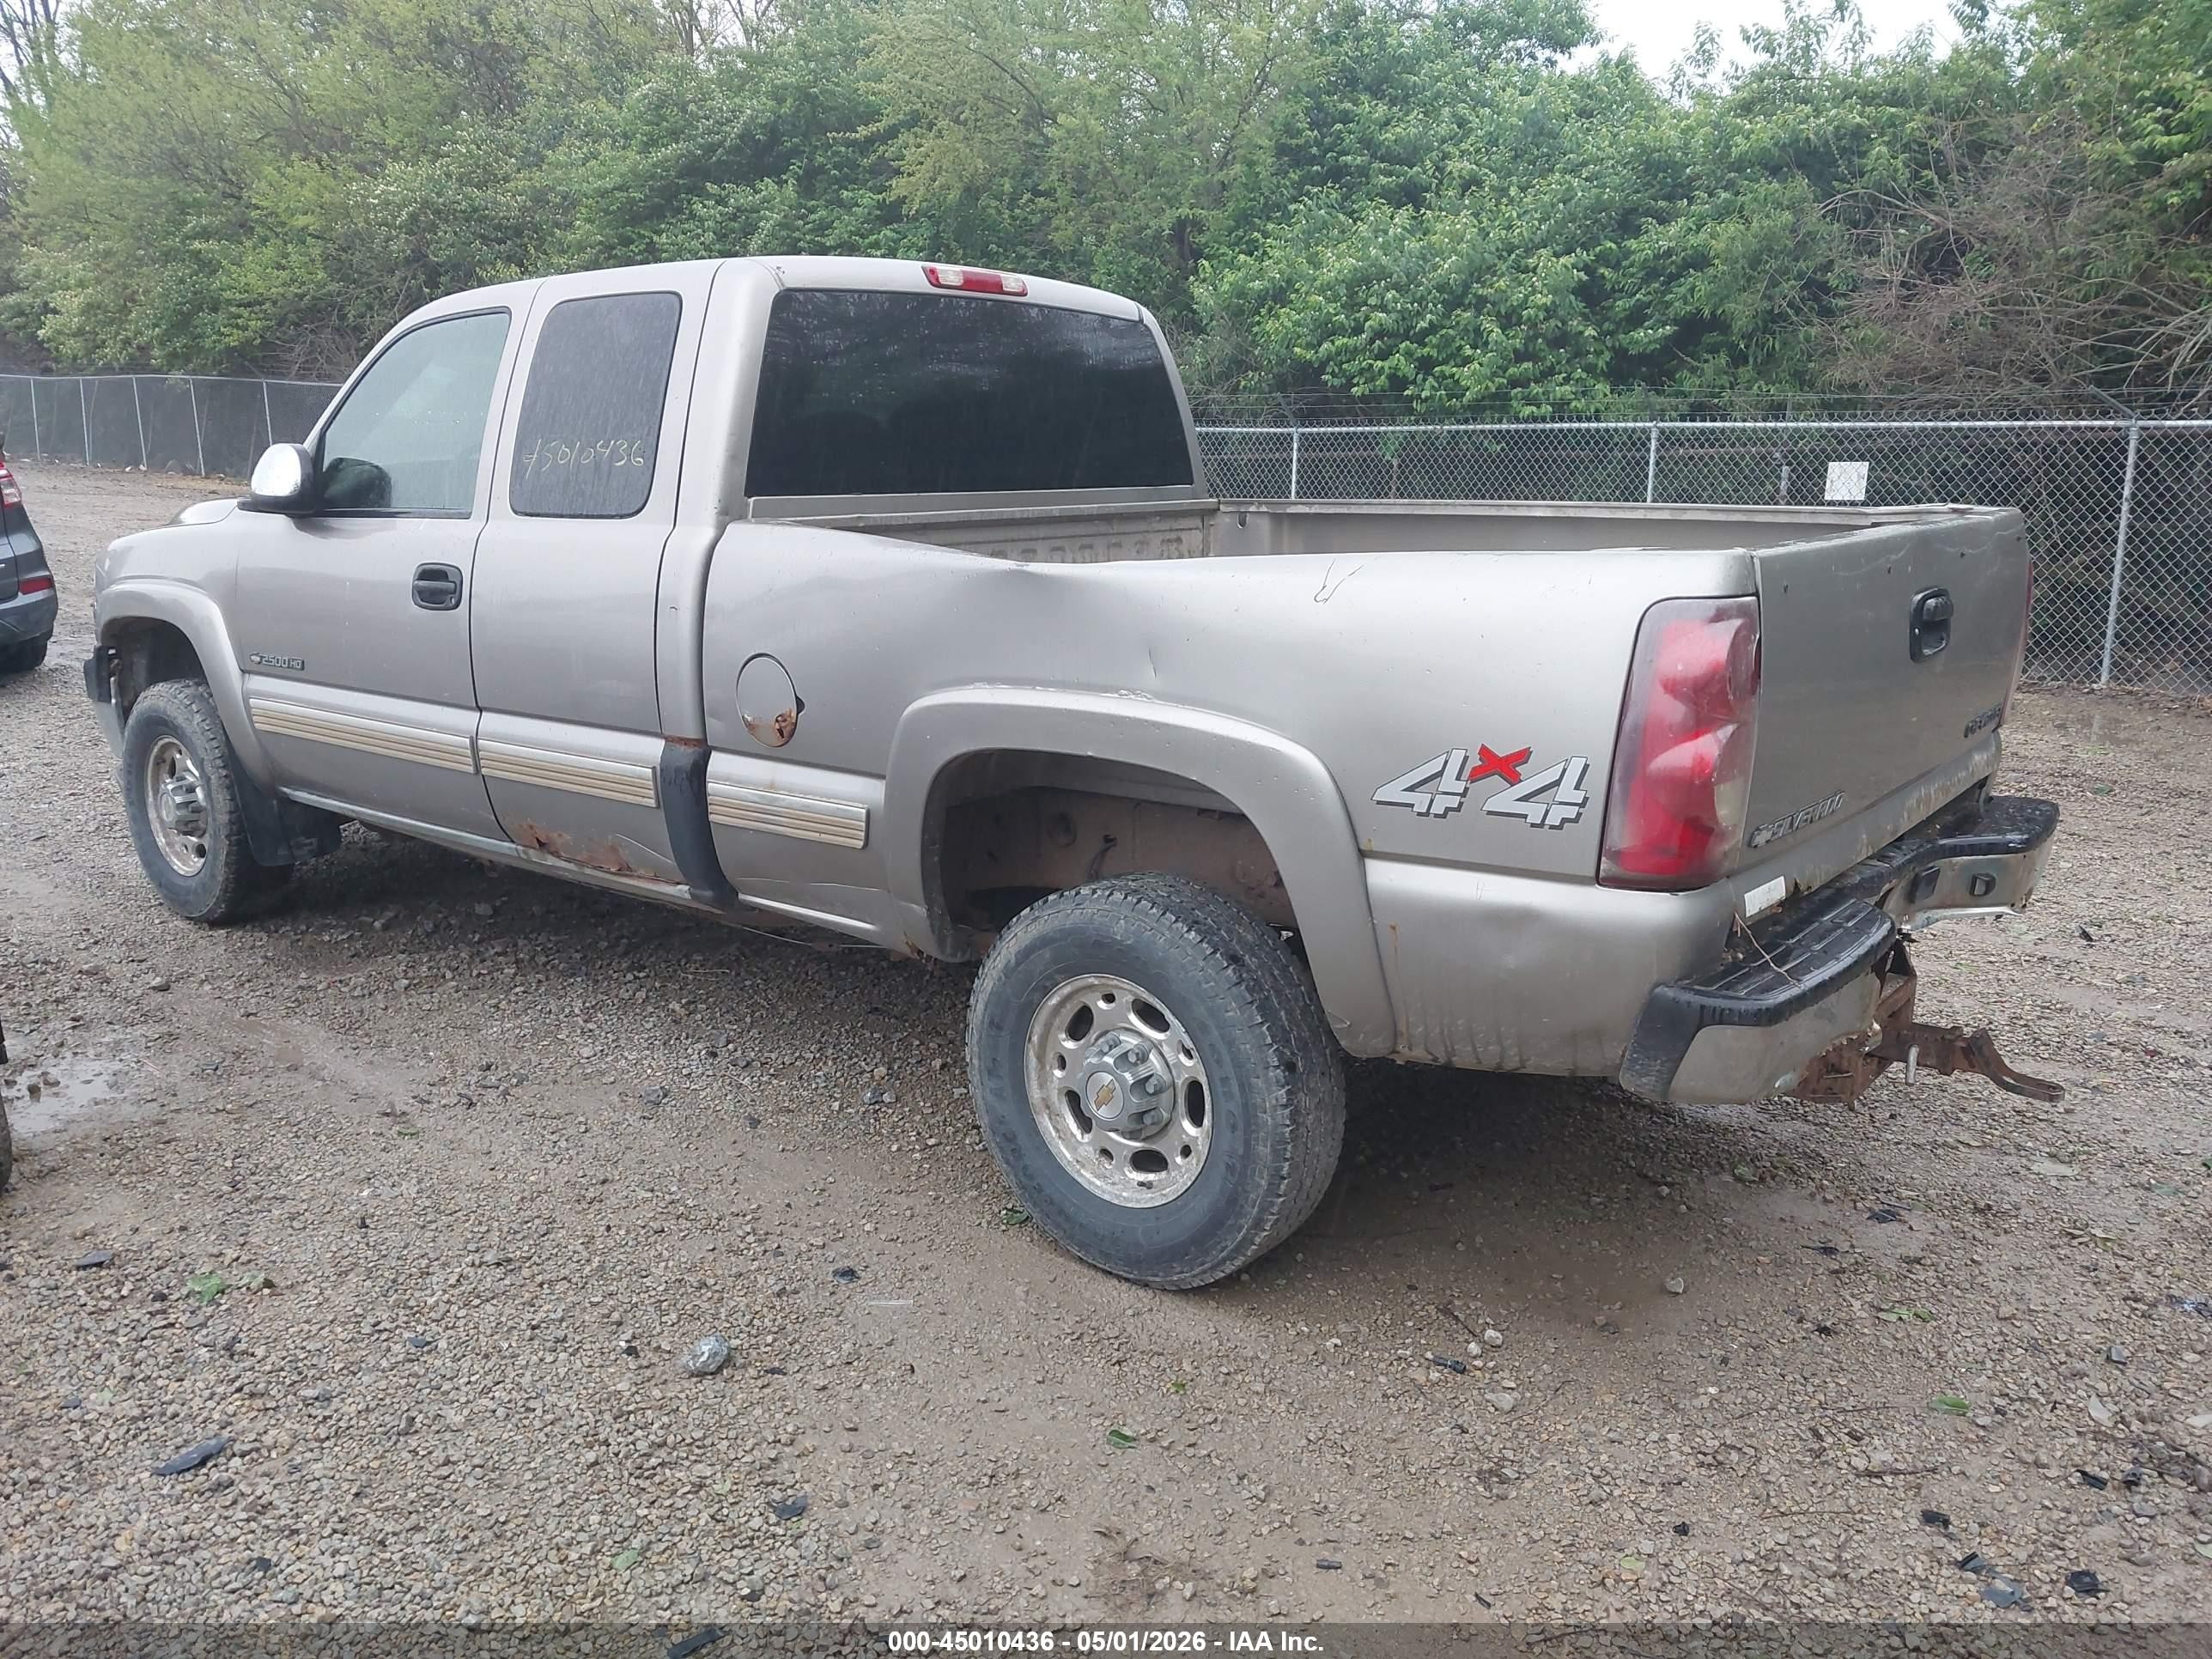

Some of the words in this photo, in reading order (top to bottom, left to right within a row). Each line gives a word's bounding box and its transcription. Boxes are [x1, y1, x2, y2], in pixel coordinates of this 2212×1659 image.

[522, 439, 644, 479] 45010436
[262, 654, 289, 667] 2500
[1771, 790, 1845, 838] SILVERADO
